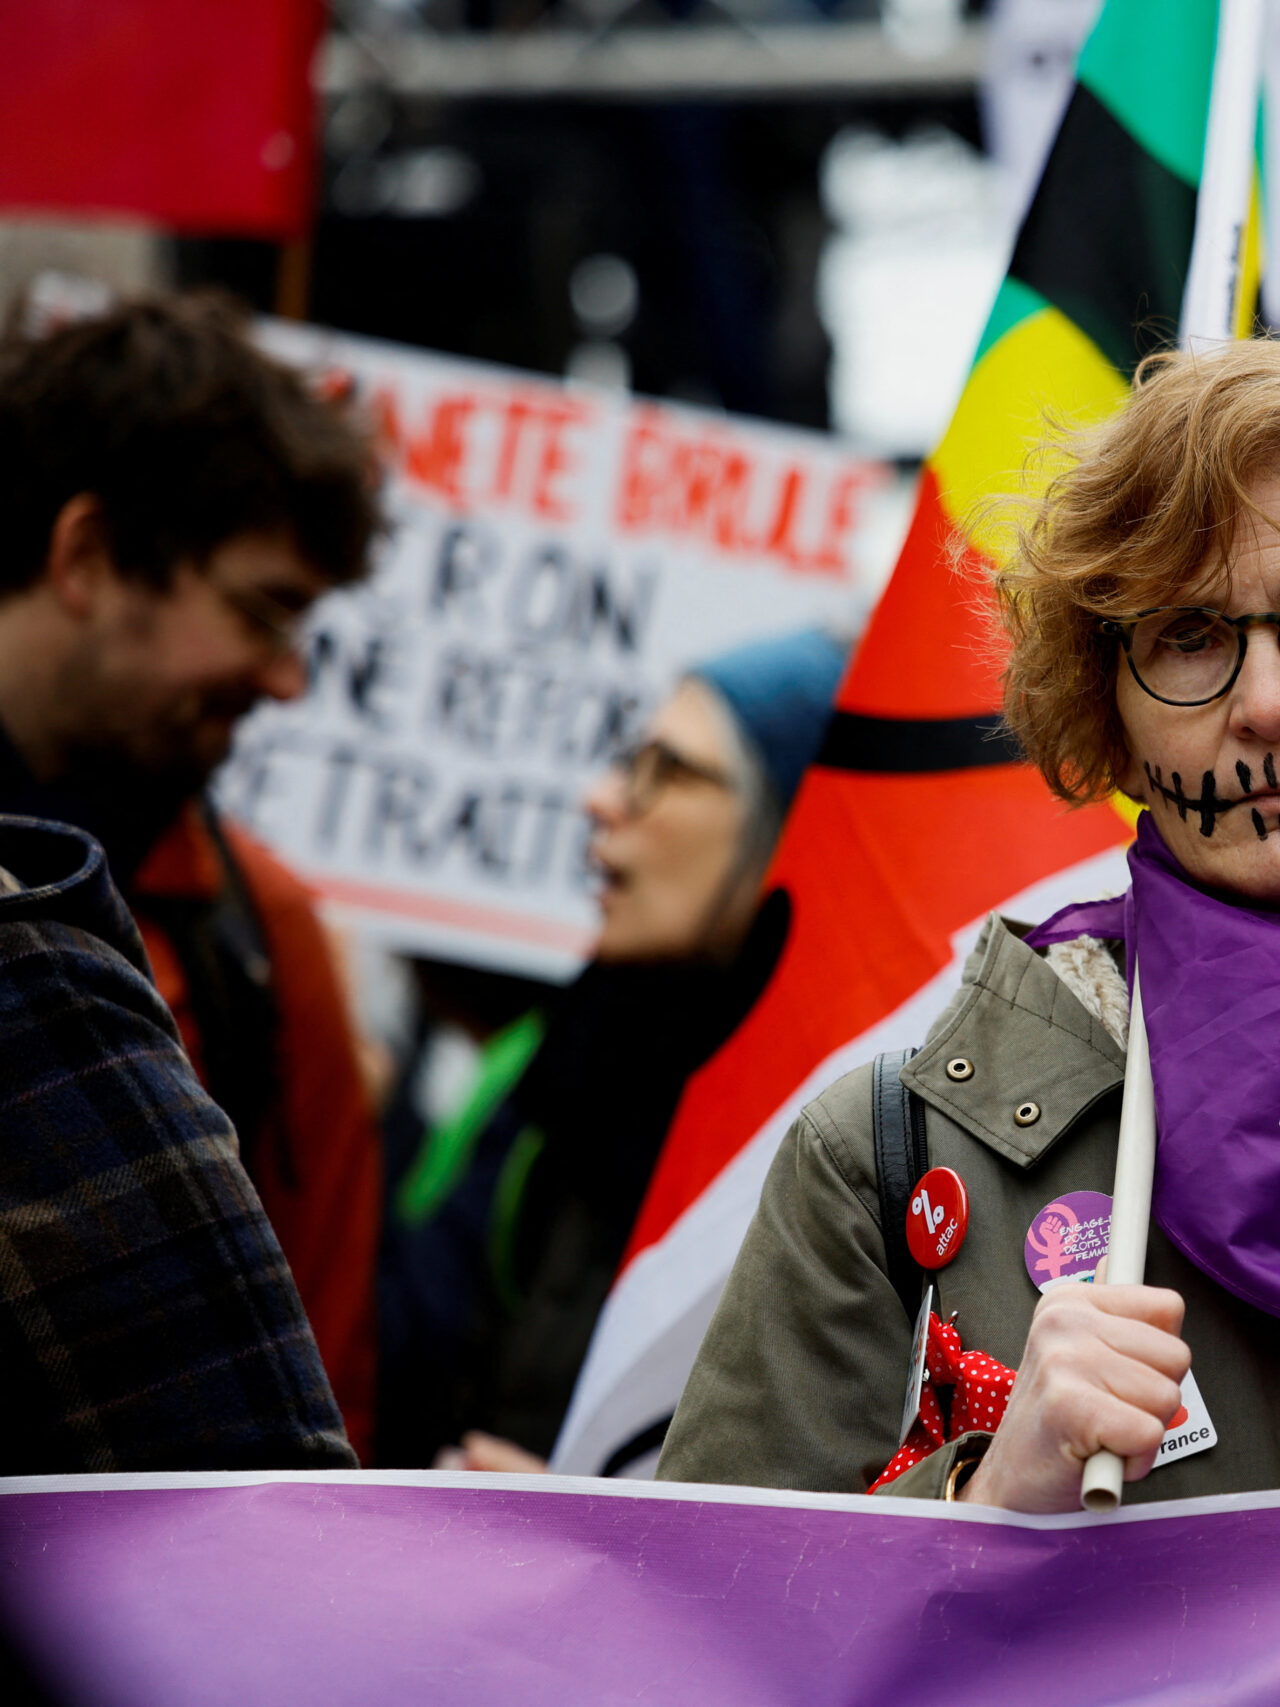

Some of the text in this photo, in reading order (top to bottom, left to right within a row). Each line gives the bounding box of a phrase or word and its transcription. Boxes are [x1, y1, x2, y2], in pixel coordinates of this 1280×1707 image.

[936, 1218, 959, 1257] attac
[1063, 1238, 1101, 1255] DROITS
[1064, 1229, 1097, 1244] POUR
[1160, 1427, 1210, 1454] rance
